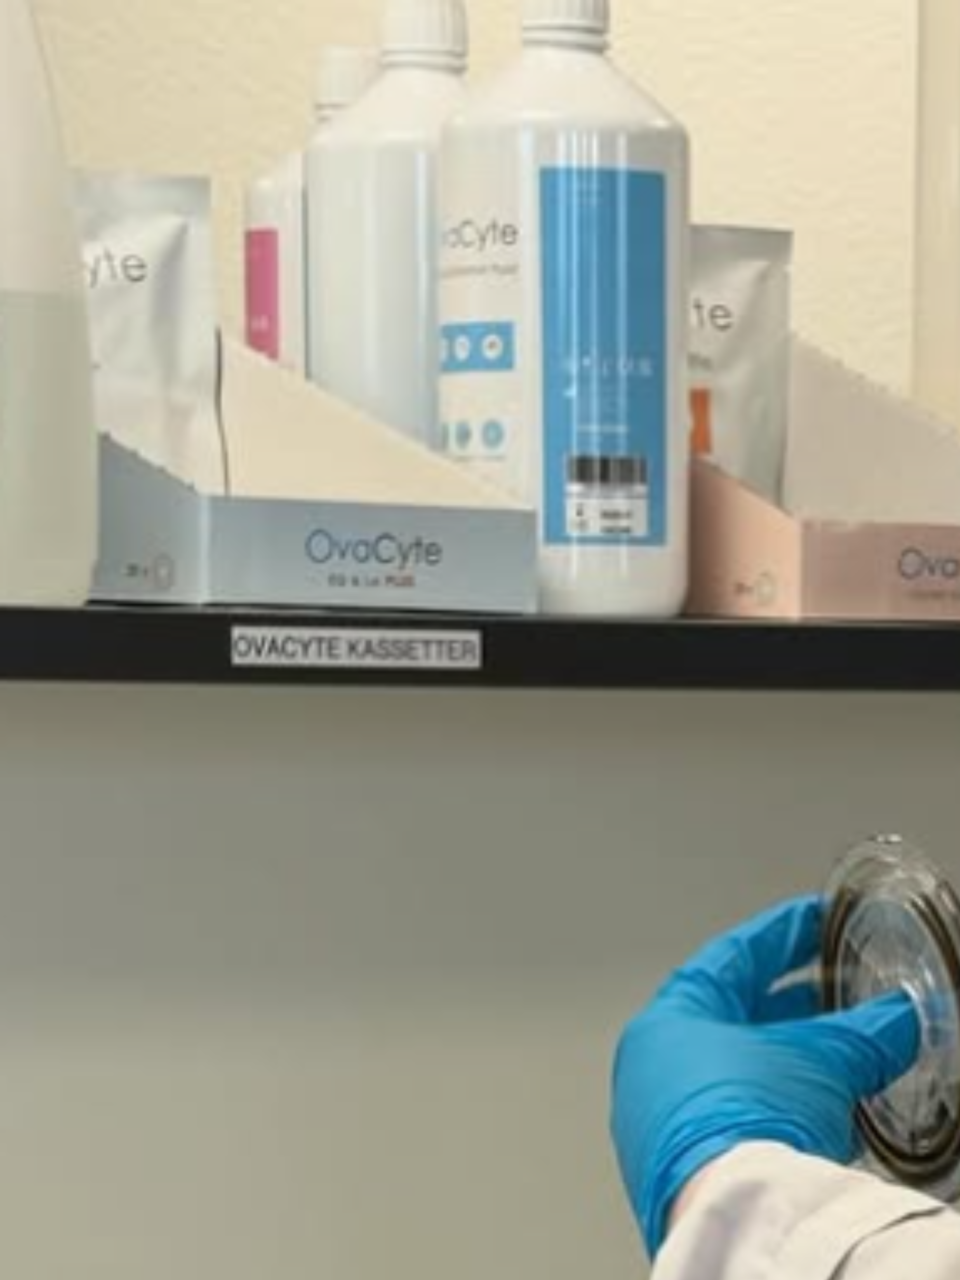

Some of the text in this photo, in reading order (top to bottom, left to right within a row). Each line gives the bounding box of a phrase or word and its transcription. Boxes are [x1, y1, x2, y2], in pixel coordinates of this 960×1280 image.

[305, 528, 442, 570] OvaCyte
[235, 636, 477, 662] OVACYTE KASSETTER
